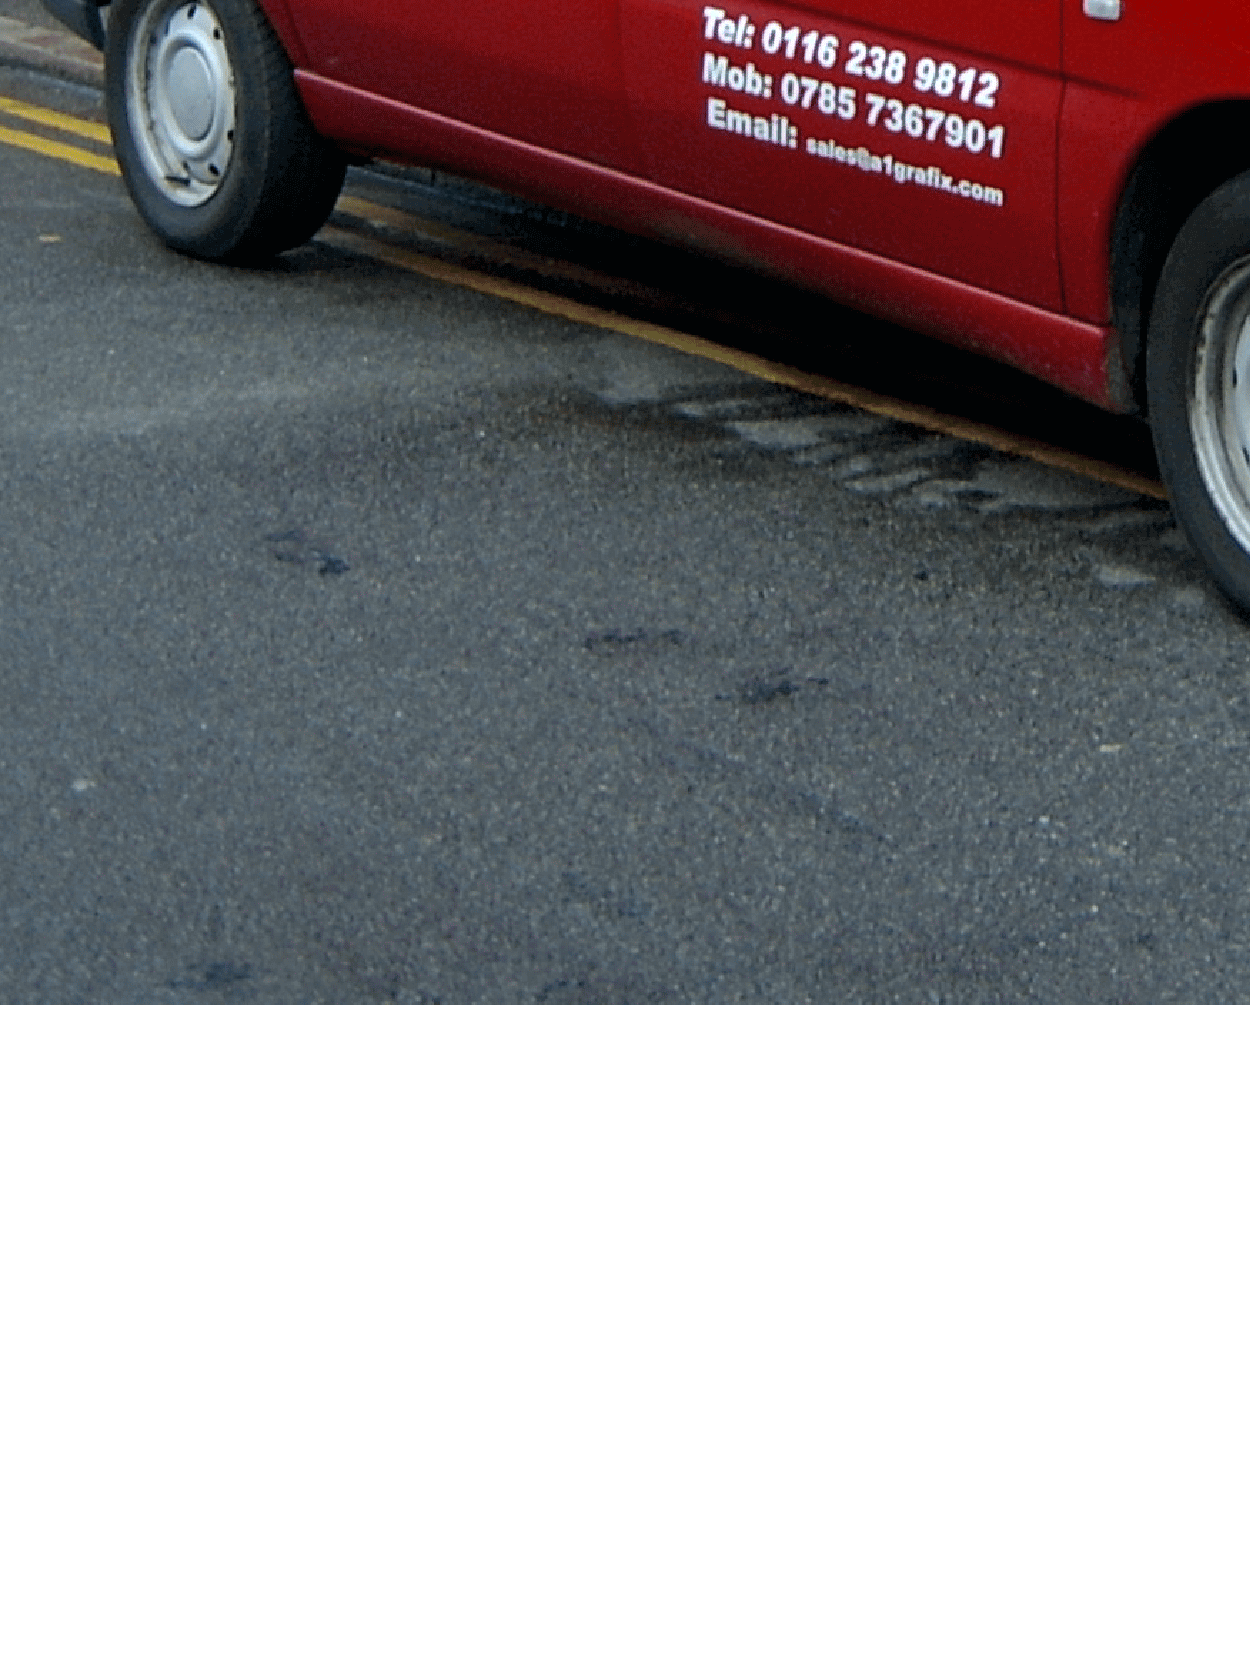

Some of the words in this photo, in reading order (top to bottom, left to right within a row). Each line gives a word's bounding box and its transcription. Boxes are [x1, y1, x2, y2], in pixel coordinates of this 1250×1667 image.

[702, 50, 774, 100] Mob:
[780, 71, 857, 120] 0785
[866, 92, 1006, 159] 7367901
[703, 6, 756, 50] Tel:
[761, 19, 840, 69] 0116
[845, 39, 907, 85] 238
[914, 56, 1001, 109] 9812
[707, 96, 800, 149] Email:
[804, 137, 1005, 207] sales@a1grafix.com
